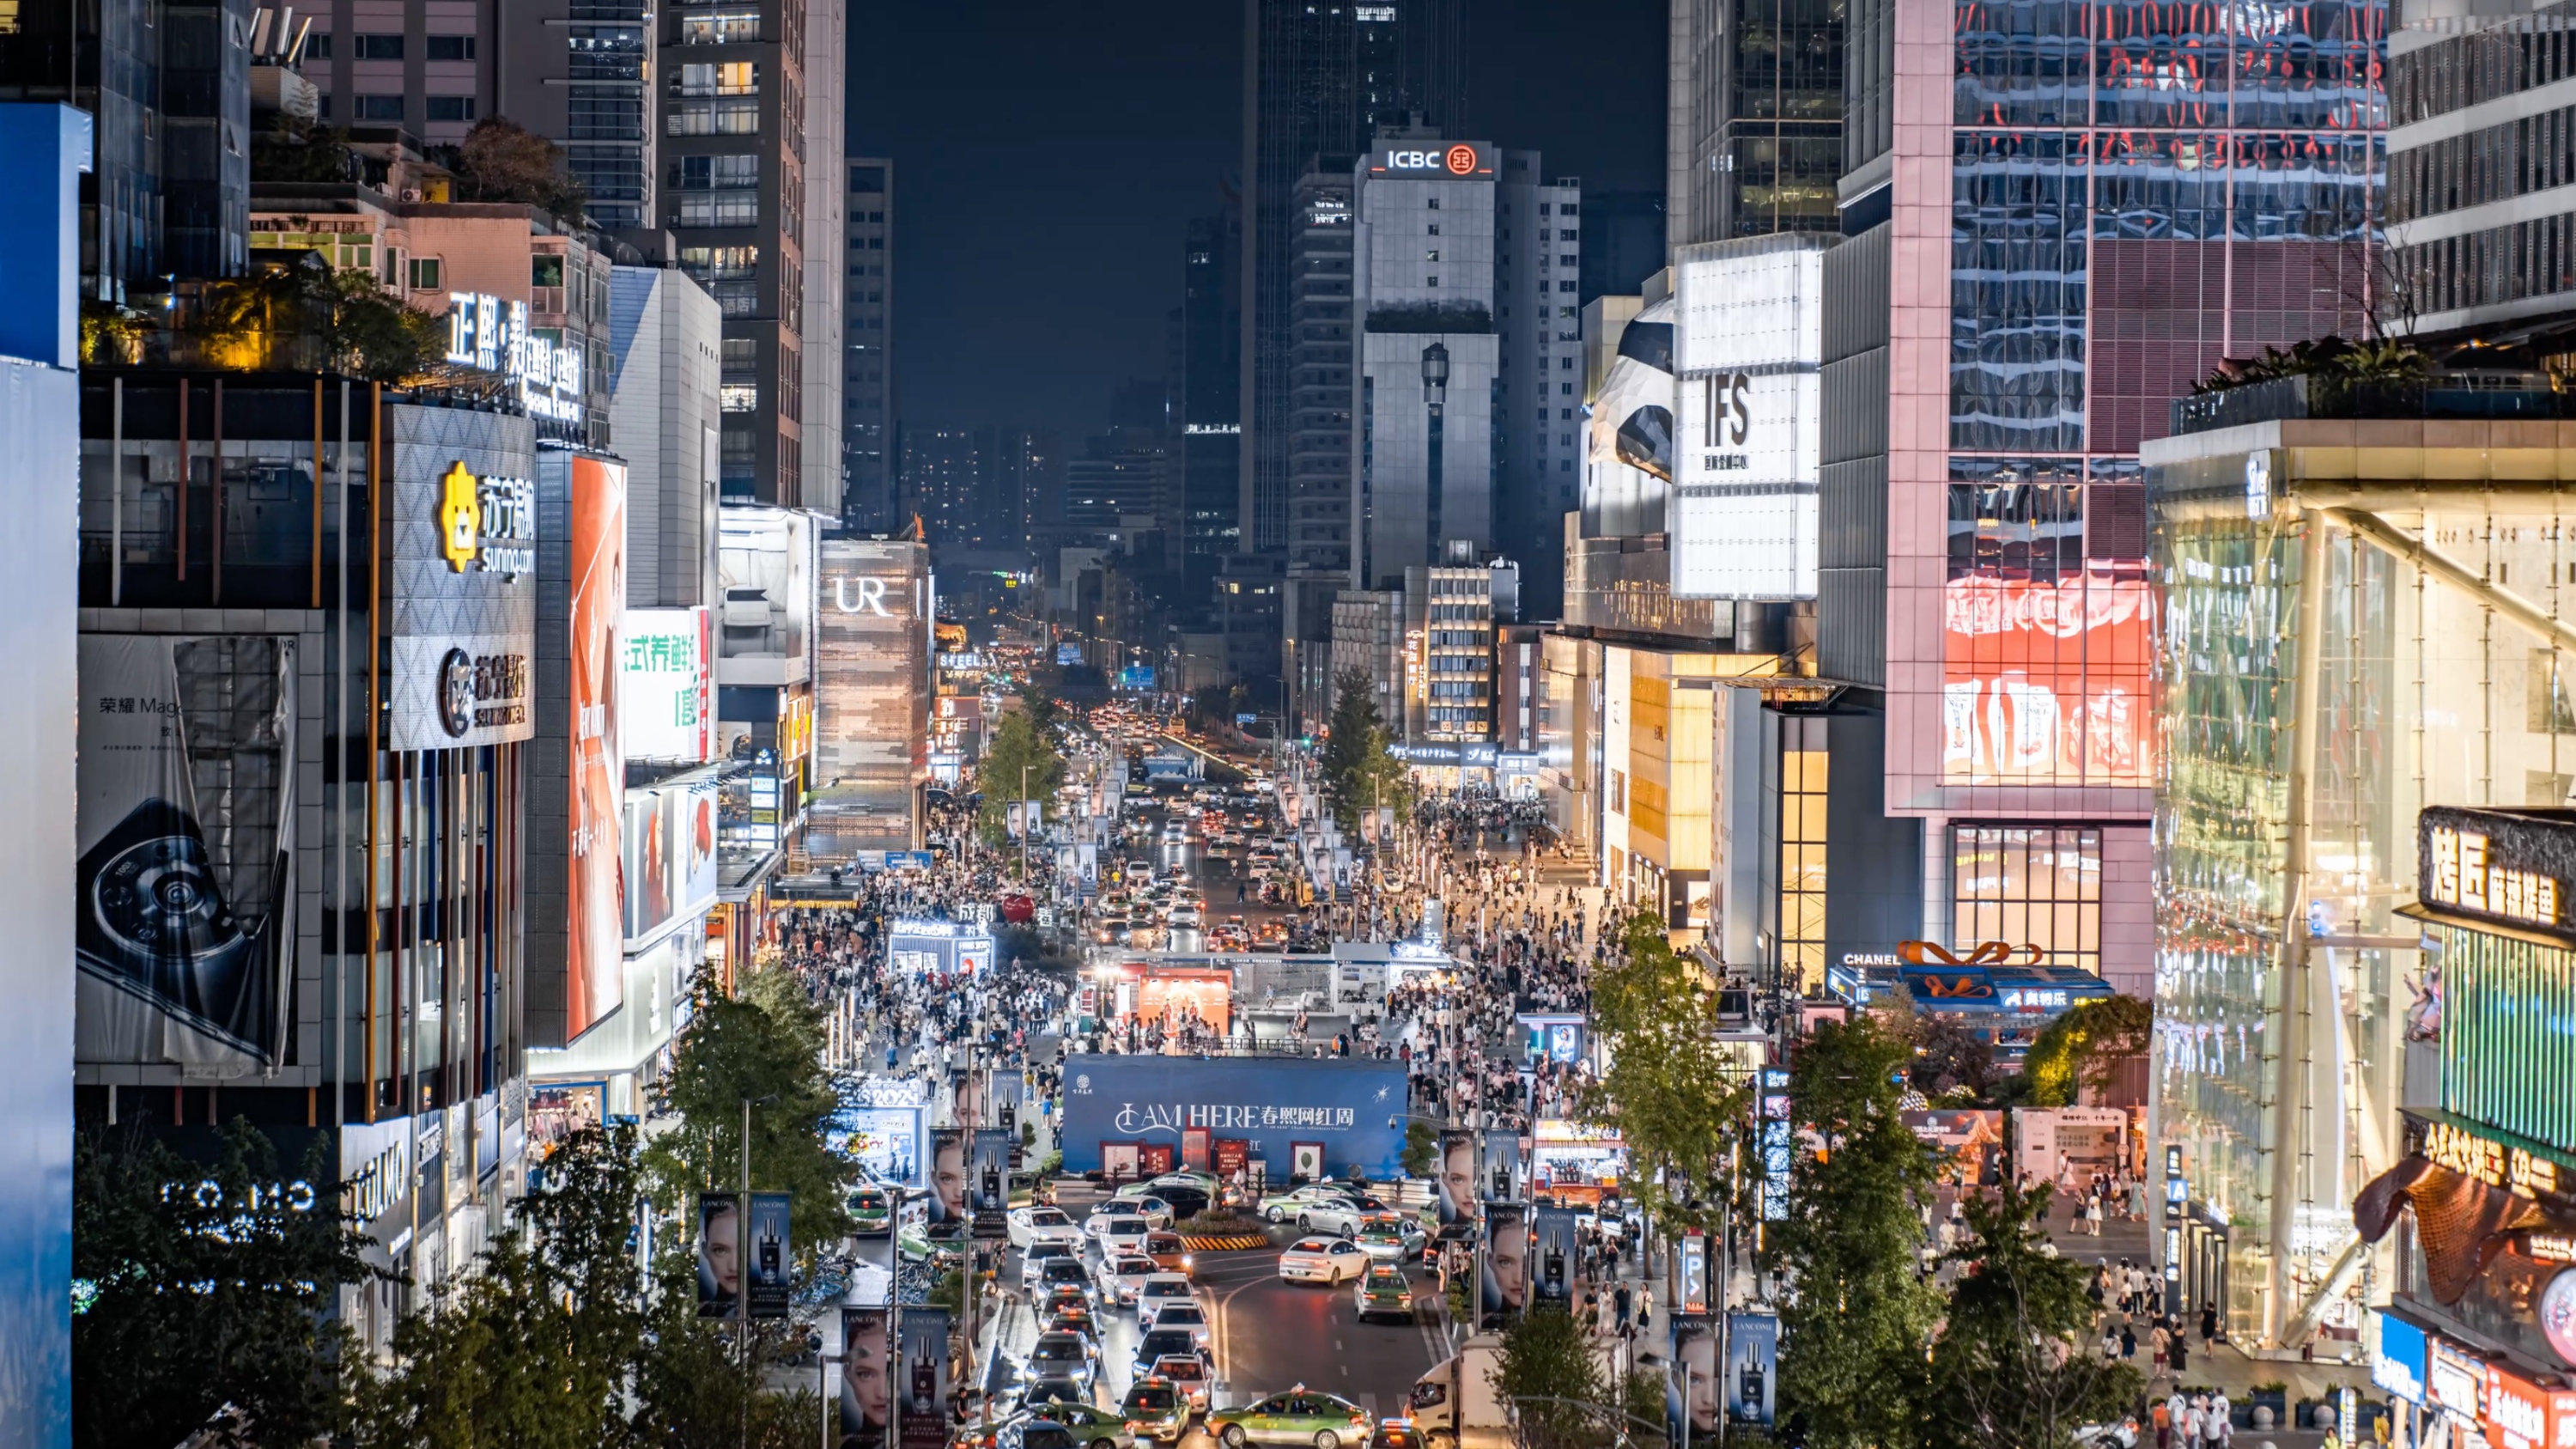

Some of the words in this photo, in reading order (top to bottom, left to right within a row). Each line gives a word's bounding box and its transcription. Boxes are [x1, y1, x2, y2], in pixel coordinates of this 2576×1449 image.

[1388, 149, 1440, 168] ICBC
[1704, 373, 1751, 447] IFS
[483, 476, 534, 540] 苏宁易购
[482, 548, 534, 584] suning.com
[833, 575, 894, 618] UR
[99, 697, 135, 715] 荣耀
[959, 904, 994, 922] 成都
[1843, 953, 1902, 965] CHANEL
[872, 1089, 919, 1105] 2024
[1140, 1104, 1182, 1127] AM
[1189, 1105, 1260, 1129] HERE
[1260, 1105, 1354, 1127] 春熙网红周
[2172, 1181, 2186, 1200] A
[1686, 1256, 1703, 1276] P
[1734, 1321, 1772, 1331] LANCÔME
